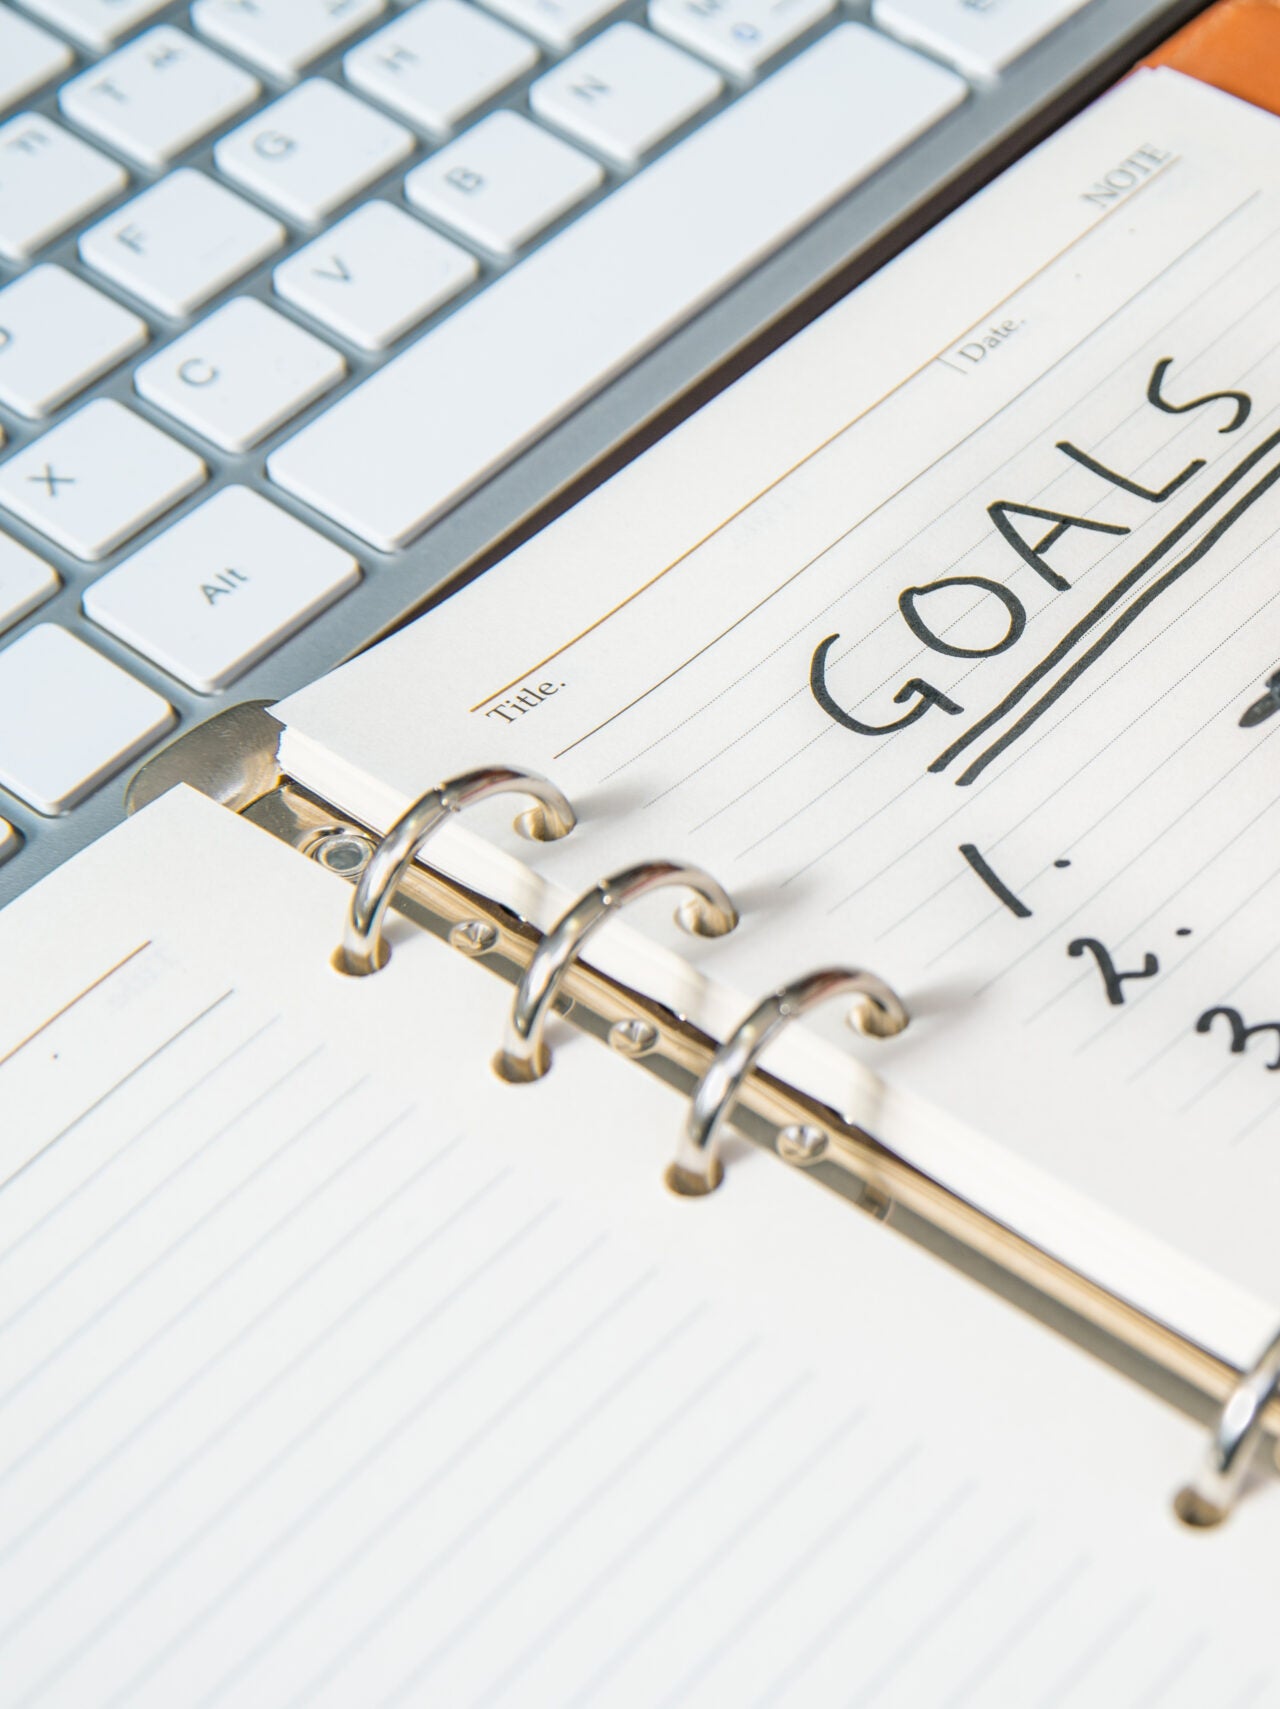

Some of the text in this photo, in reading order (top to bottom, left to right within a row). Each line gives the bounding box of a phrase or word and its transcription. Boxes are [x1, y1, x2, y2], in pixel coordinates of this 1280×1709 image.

[376, 42, 418, 74] H
[90, 74, 128, 104] T
[568, 73, 610, 103] N
[252, 130, 297, 160] G
[443, 165, 484, 195] B
[1080, 142, 1173, 208] NOTE
[115, 222, 146, 255] F
[312, 255, 352, 285] V
[957, 319, 1026, 363] Date.
[178, 358, 219, 388] C
[28, 464, 75, 496] X
[810, 356, 1252, 737] GOALS
[200, 567, 249, 605] Alt
[485, 681, 567, 724] Title.
[959, 843, 1071, 918] 1.
[1067, 926, 1192, 1006] 2.
